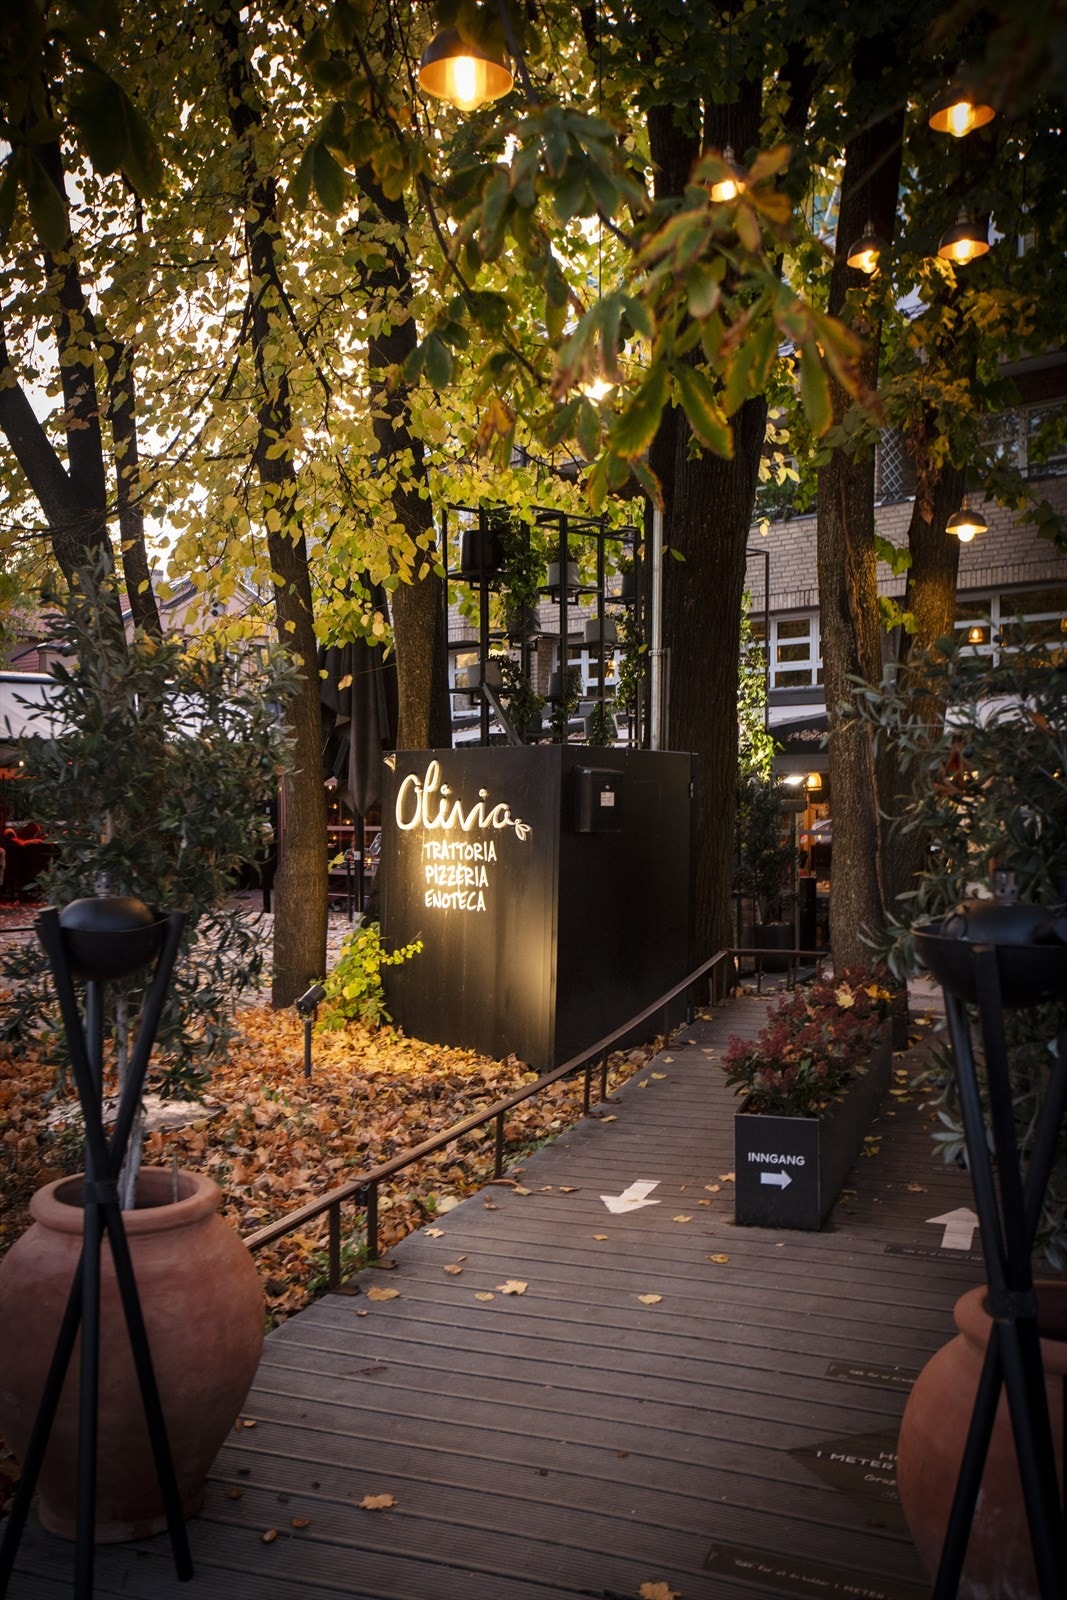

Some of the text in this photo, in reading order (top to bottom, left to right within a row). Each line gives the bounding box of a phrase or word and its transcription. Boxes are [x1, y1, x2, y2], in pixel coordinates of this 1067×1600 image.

[395, 759, 517, 831] Olivia
[423, 840, 498, 862] TRATTORIA
[425, 863, 490, 888] PIZZERIA
[424, 890, 487, 912] ENOTECA
[747, 1151, 806, 1166] INNGANG
[830, 1452, 894, 1471] METER
